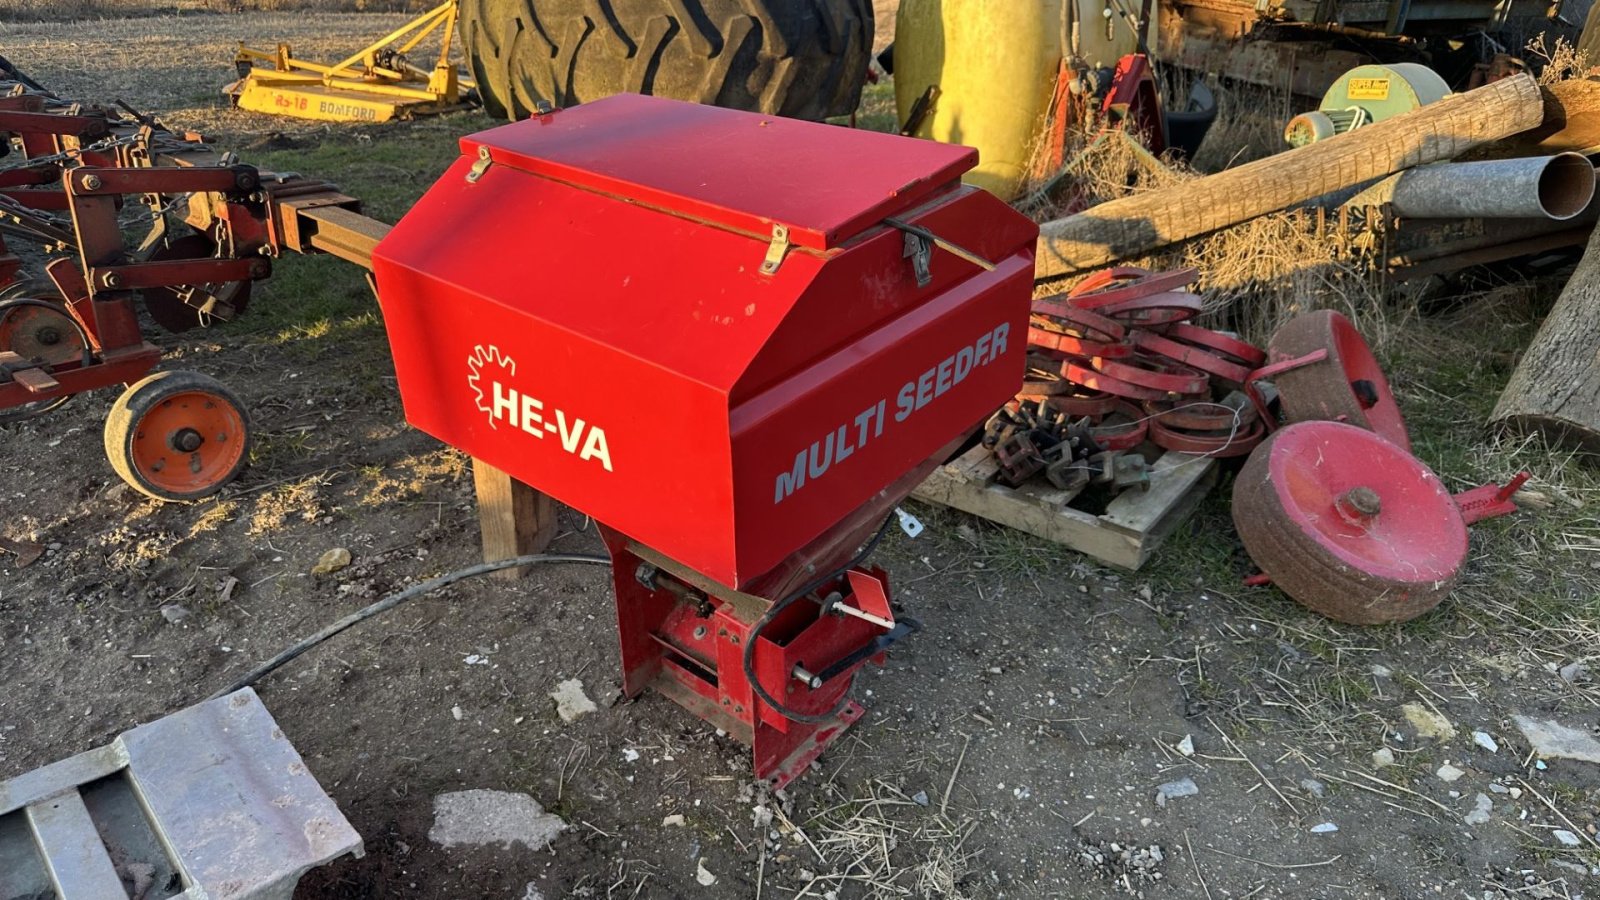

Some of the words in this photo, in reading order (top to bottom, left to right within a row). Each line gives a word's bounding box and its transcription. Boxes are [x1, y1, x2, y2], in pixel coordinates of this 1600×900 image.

[319, 101, 377, 120] BOMFORD
[492, 381, 613, 472] HE-VA
[774, 398, 886, 504] MULTI
[894, 321, 1010, 423] SEEDER
